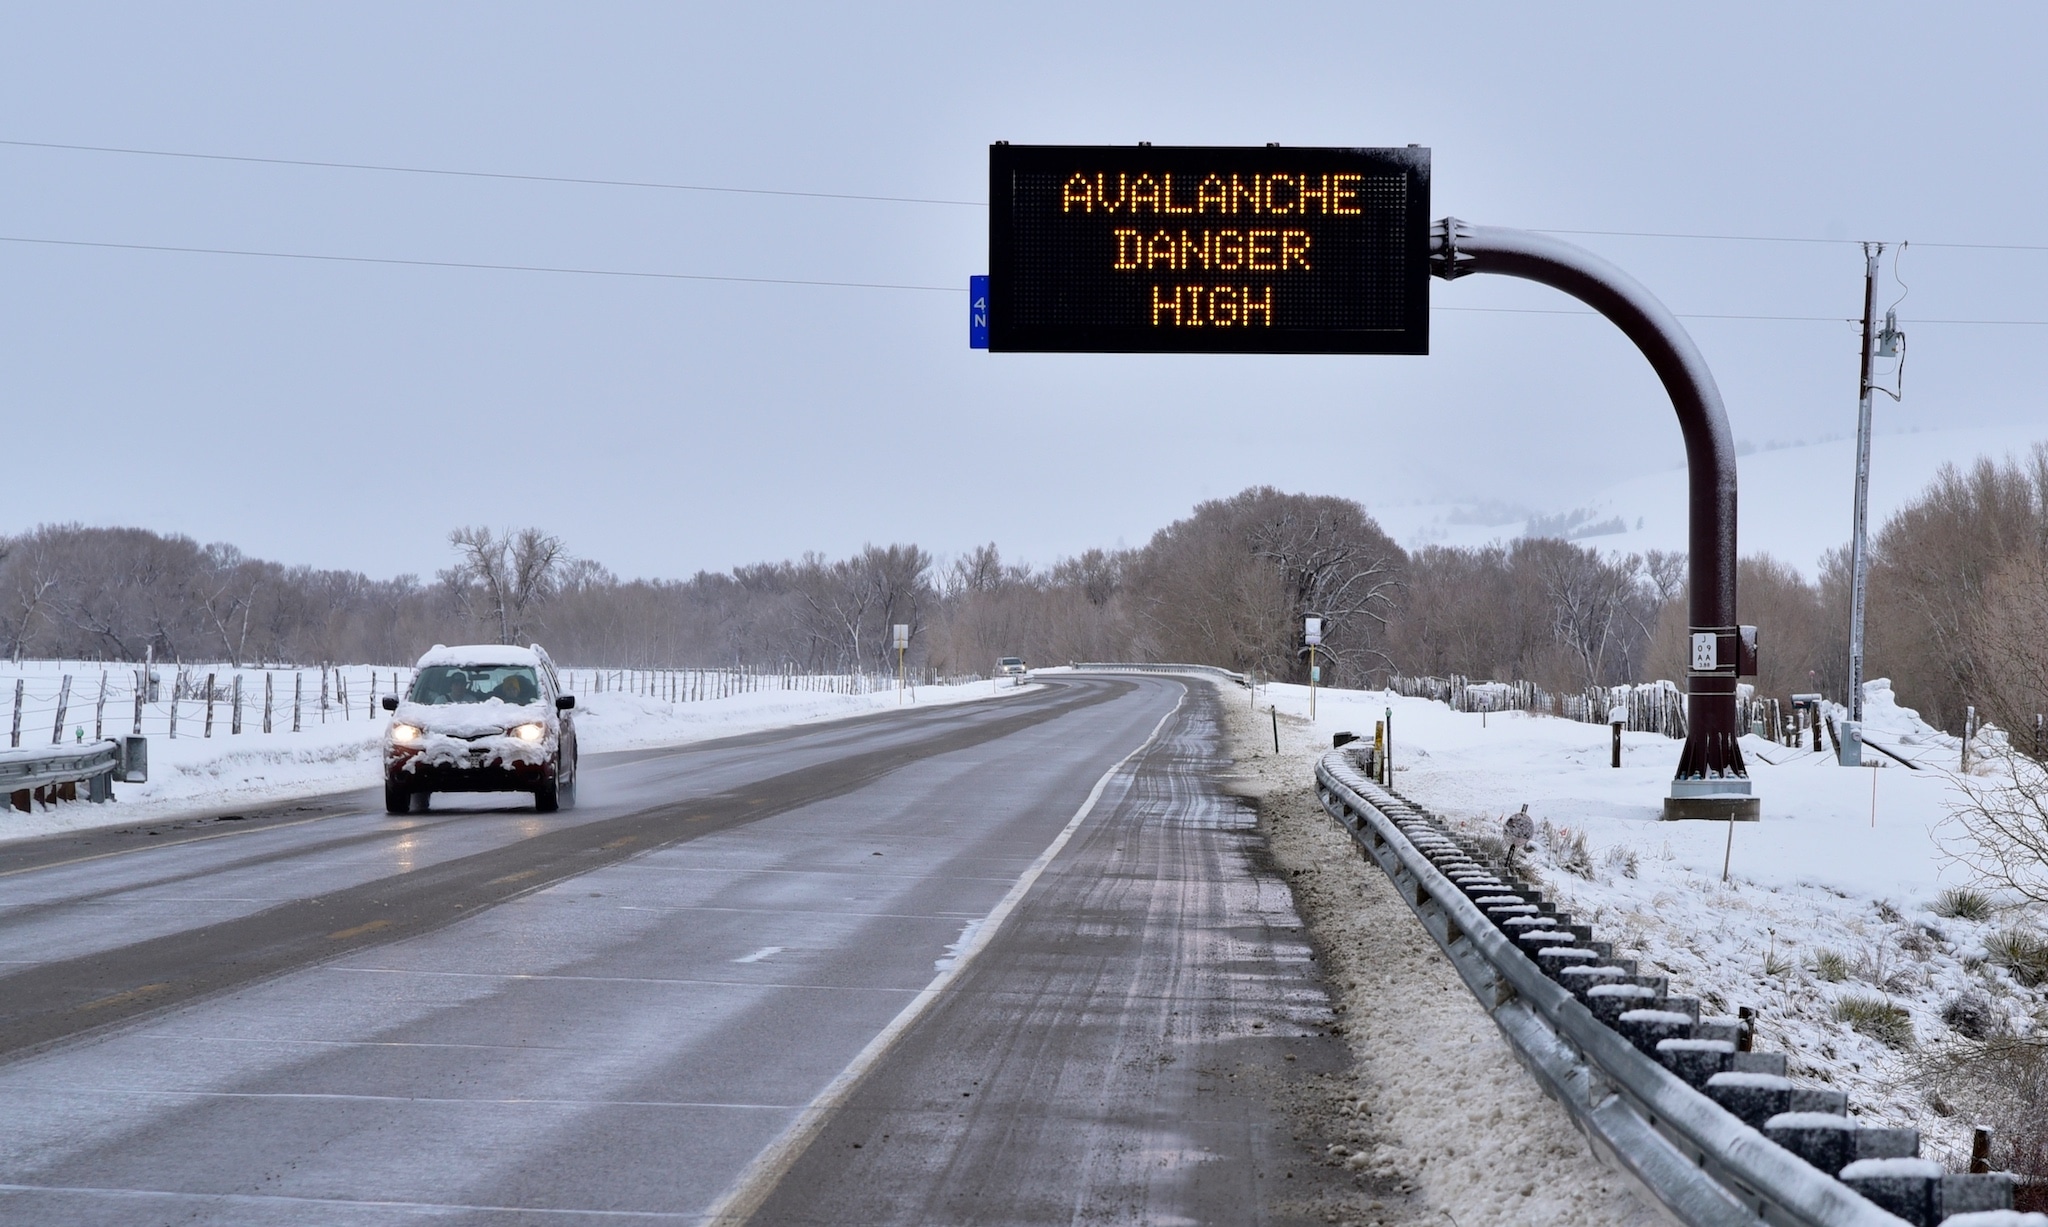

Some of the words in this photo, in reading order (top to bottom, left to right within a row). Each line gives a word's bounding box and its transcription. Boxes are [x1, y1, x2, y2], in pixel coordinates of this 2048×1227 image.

[1063, 172, 1362, 215] AVALANCHE
[1113, 229, 1312, 271] DANGER
[973, 297, 986, 310] 4
[1152, 285, 1271, 327] HIGH
